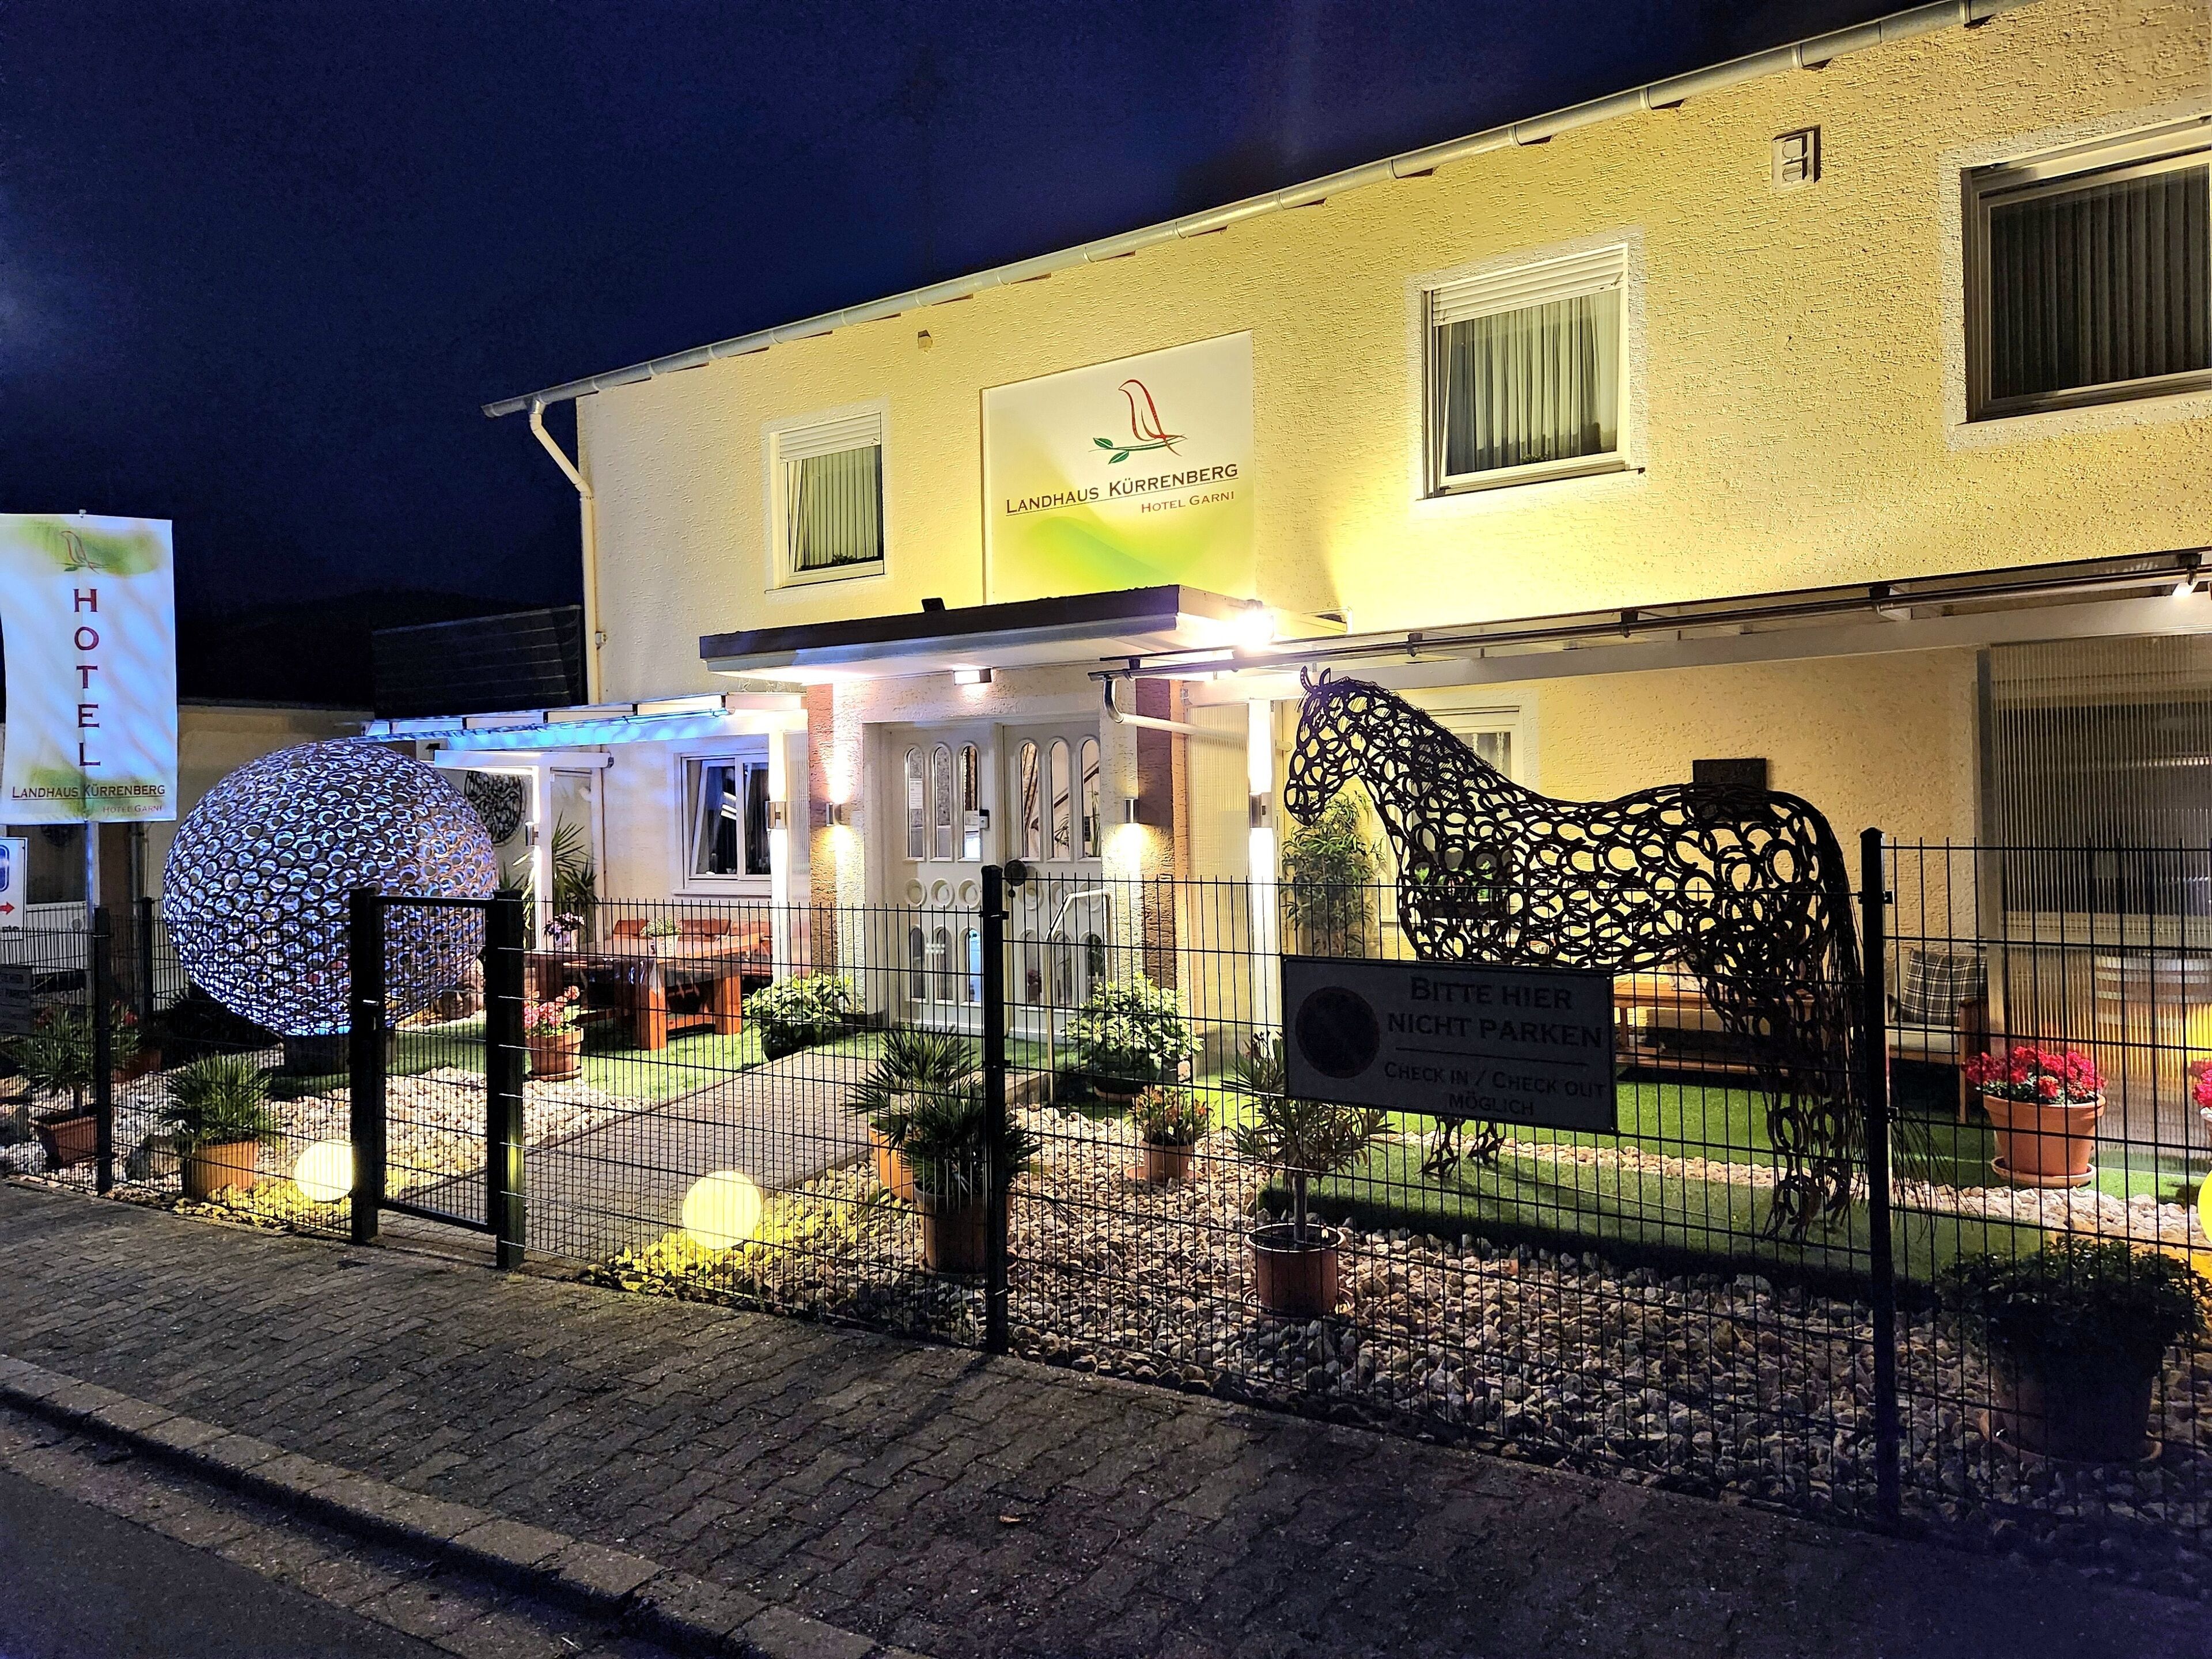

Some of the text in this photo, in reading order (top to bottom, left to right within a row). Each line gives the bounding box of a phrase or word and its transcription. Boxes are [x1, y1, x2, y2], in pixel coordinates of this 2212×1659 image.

[1006, 464, 1238, 514] LANDHAUS KÜRRENBERG
[1141, 491, 1235, 513] HOTEL GARNI
[73, 588, 101, 766] HOTEL
[12, 784, 165, 798] LANDHAUS KÜRRENBERG
[1410, 976, 1572, 1009] BITTE HIER
[1388, 1013, 1602, 1048] NICHT PARKEN
[1384, 1061, 1444, 1083] CHECK
[1450, 1070, 1468, 1086] IN
[1493, 1071, 1556, 1094] CHECK
[1565, 1081, 1605, 1097] OUT
[1448, 1091, 1535, 1116] MÖGLICH
